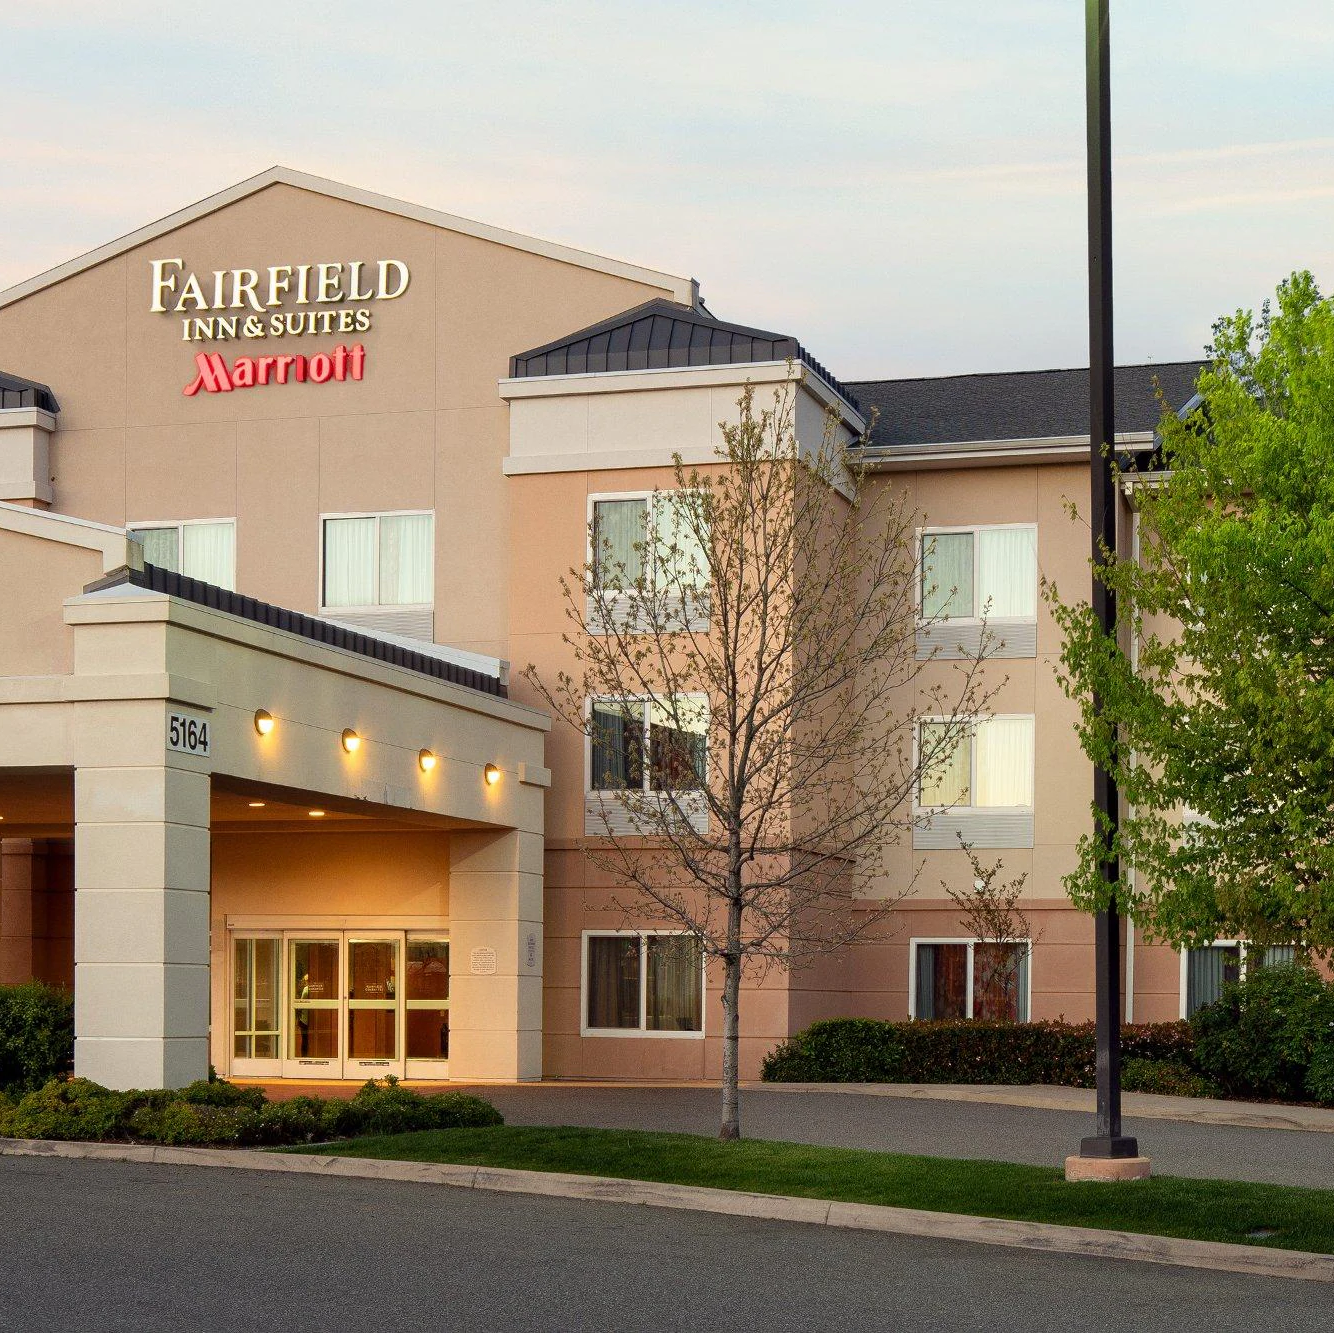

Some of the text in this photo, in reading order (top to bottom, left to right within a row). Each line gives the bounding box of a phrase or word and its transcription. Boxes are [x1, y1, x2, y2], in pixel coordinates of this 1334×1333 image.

[149, 258, 411, 313] FAIRFIELD
[182, 308, 371, 341] INN & SUITES
[182, 343, 365, 397] Marriott
[169, 715, 209, 752] 5164
